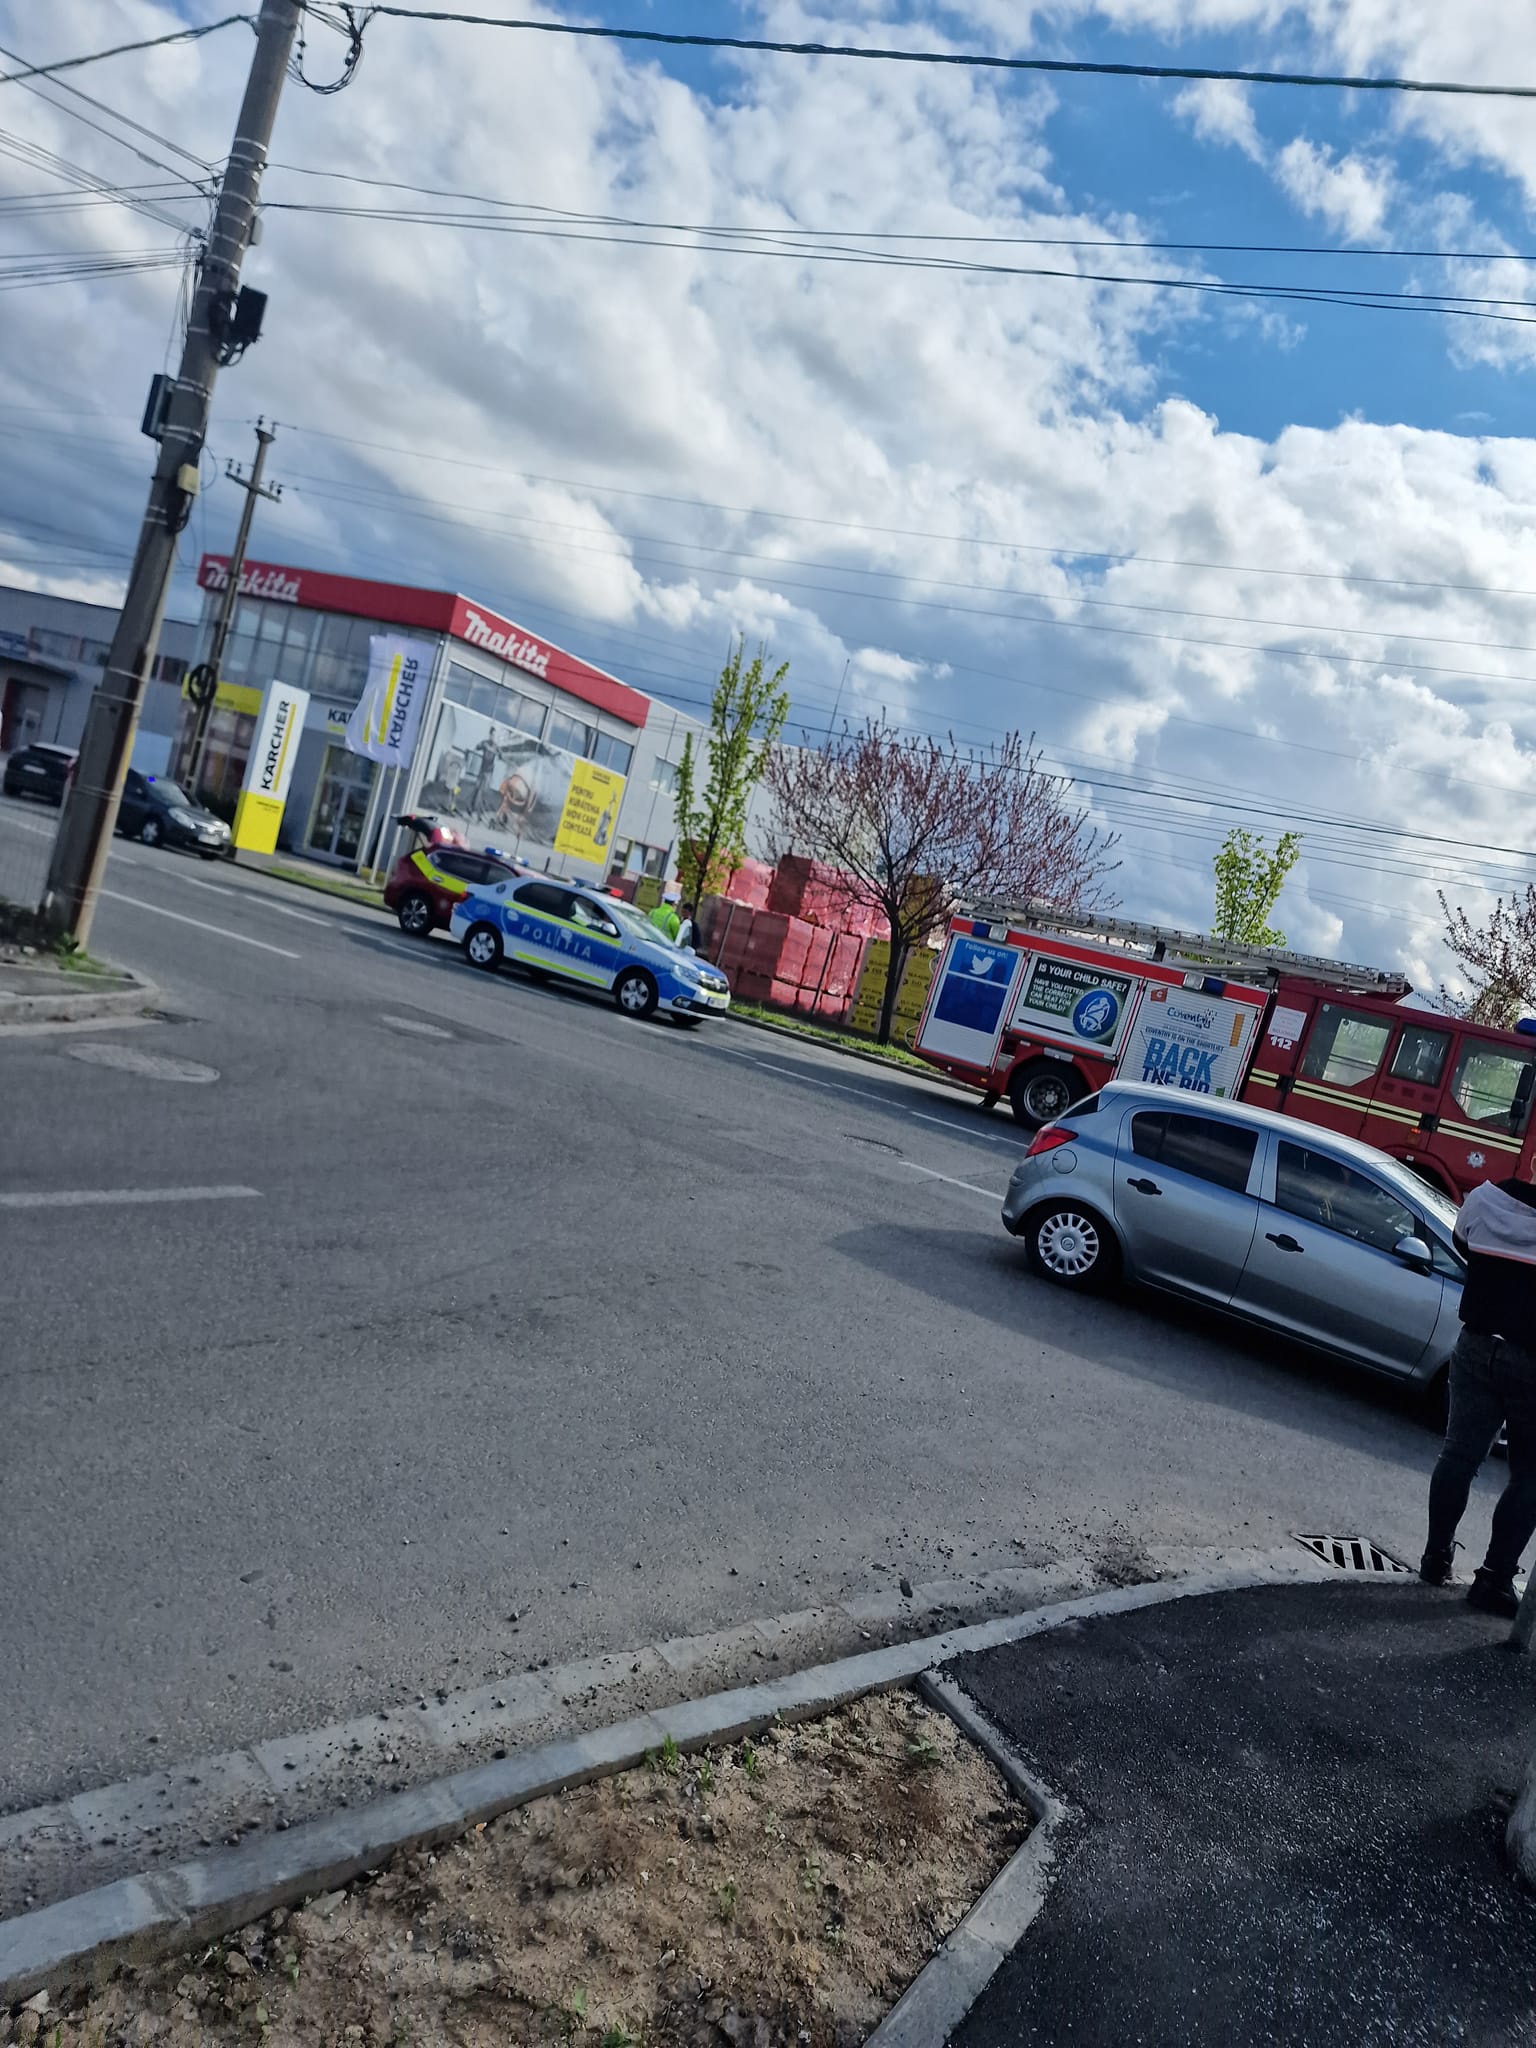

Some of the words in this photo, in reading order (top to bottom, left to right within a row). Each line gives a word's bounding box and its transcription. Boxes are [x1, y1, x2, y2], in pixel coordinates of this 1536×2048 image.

[463, 609, 548, 678] Makita
[965, 942, 986, 954] Follow
[987, 948, 996, 956] us
[1034, 978, 1050, 986] HAVE
[1051, 981, 1063, 989] YOU
[1063, 984, 1084, 995] FITTED
[1038, 963, 1047, 972] IS
[1049, 965, 1073, 978] YOUR
[1073, 972, 1099, 985] CHILD
[1100, 978, 1128, 993] SAFE?
[1032, 984, 1043, 992] THE
[1045, 987, 1073, 1000] CORRECT
[1029, 997, 1044, 1007] YOUR
[1167, 1007, 1211, 1029] Coventry
[1270, 1036, 1292, 1050] 112
[1143, 1037, 1219, 1083] BACK
[1142, 1065, 1177, 1086] THE
